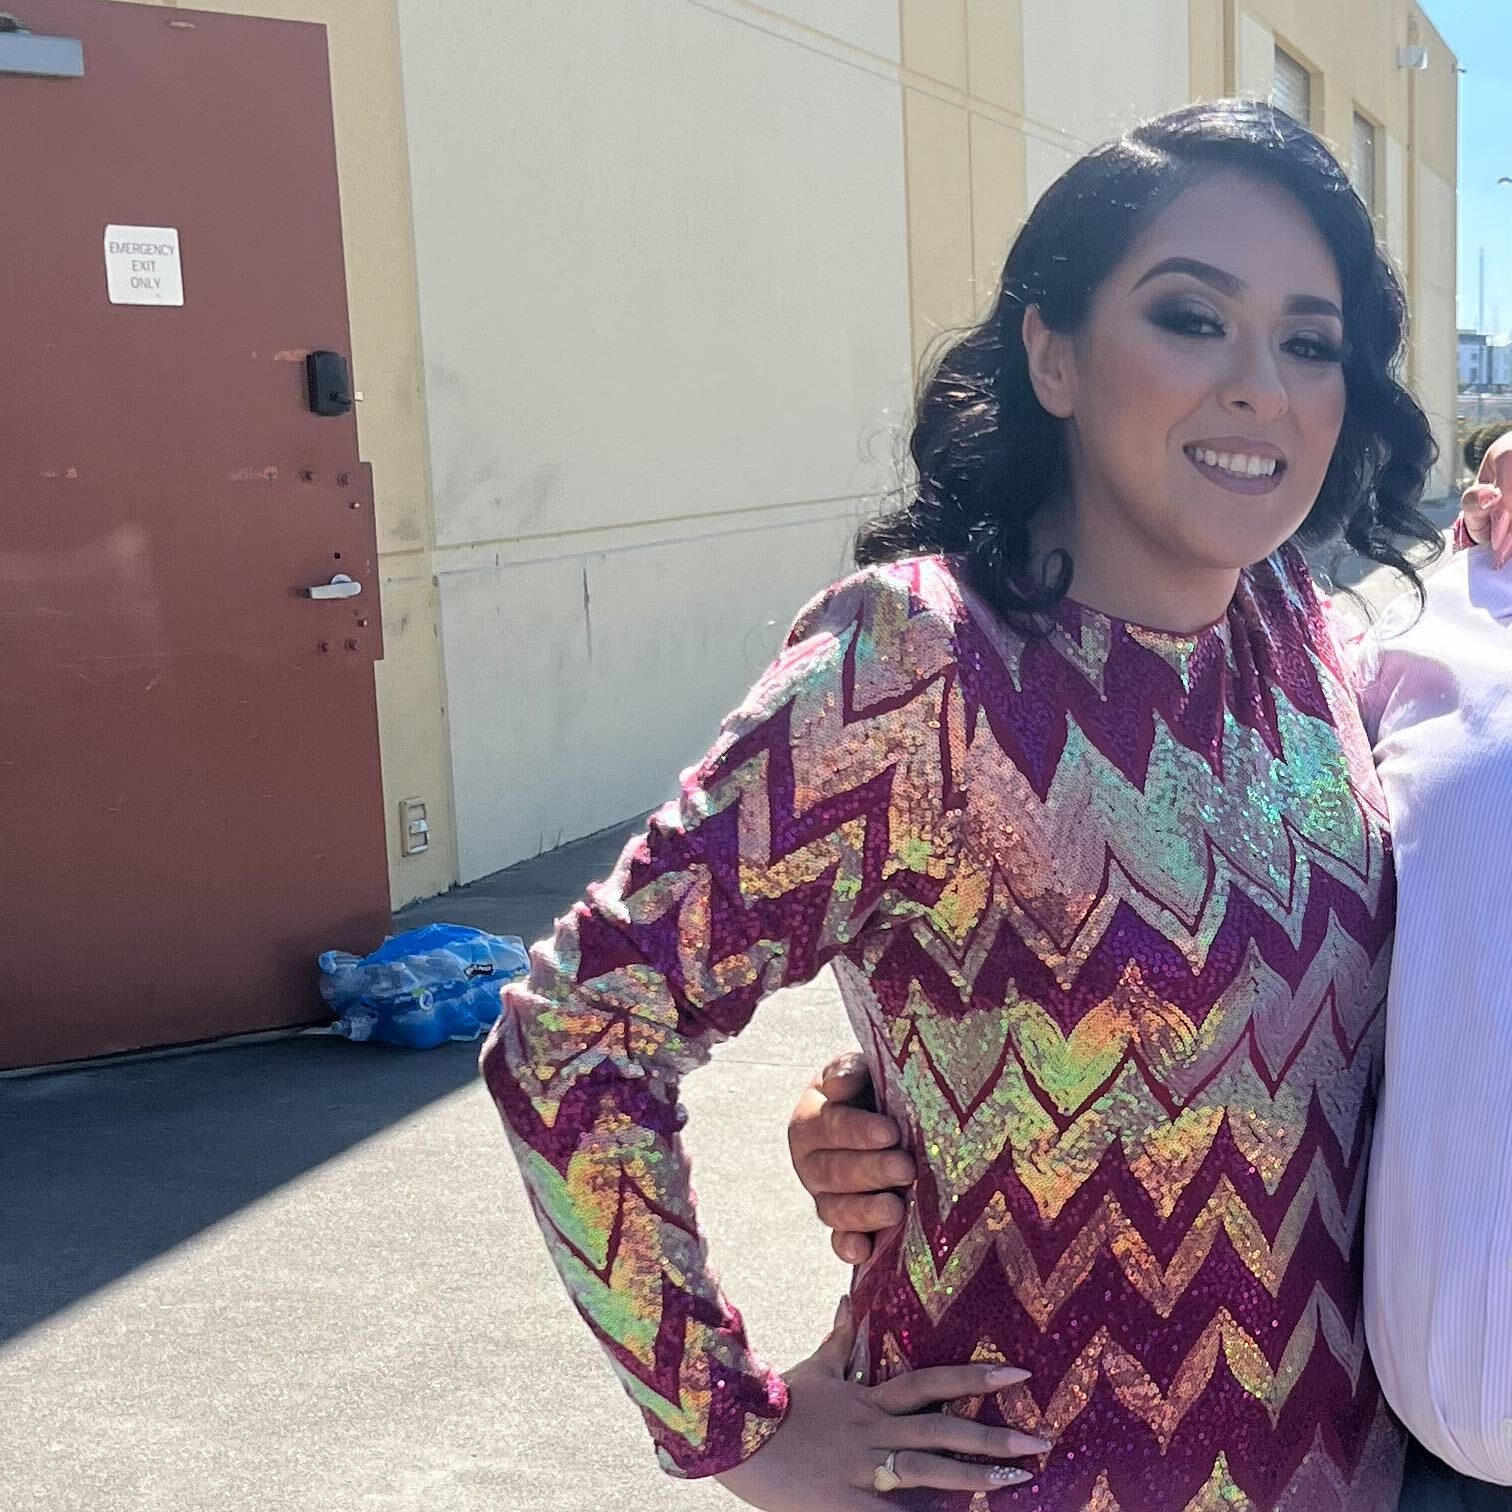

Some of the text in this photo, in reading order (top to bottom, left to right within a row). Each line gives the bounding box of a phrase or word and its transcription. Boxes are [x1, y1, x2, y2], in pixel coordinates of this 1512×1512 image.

[109, 241, 176, 256] EMERGENCY
[131, 259, 156, 272] EXIT
[130, 276, 161, 289] ONLY
